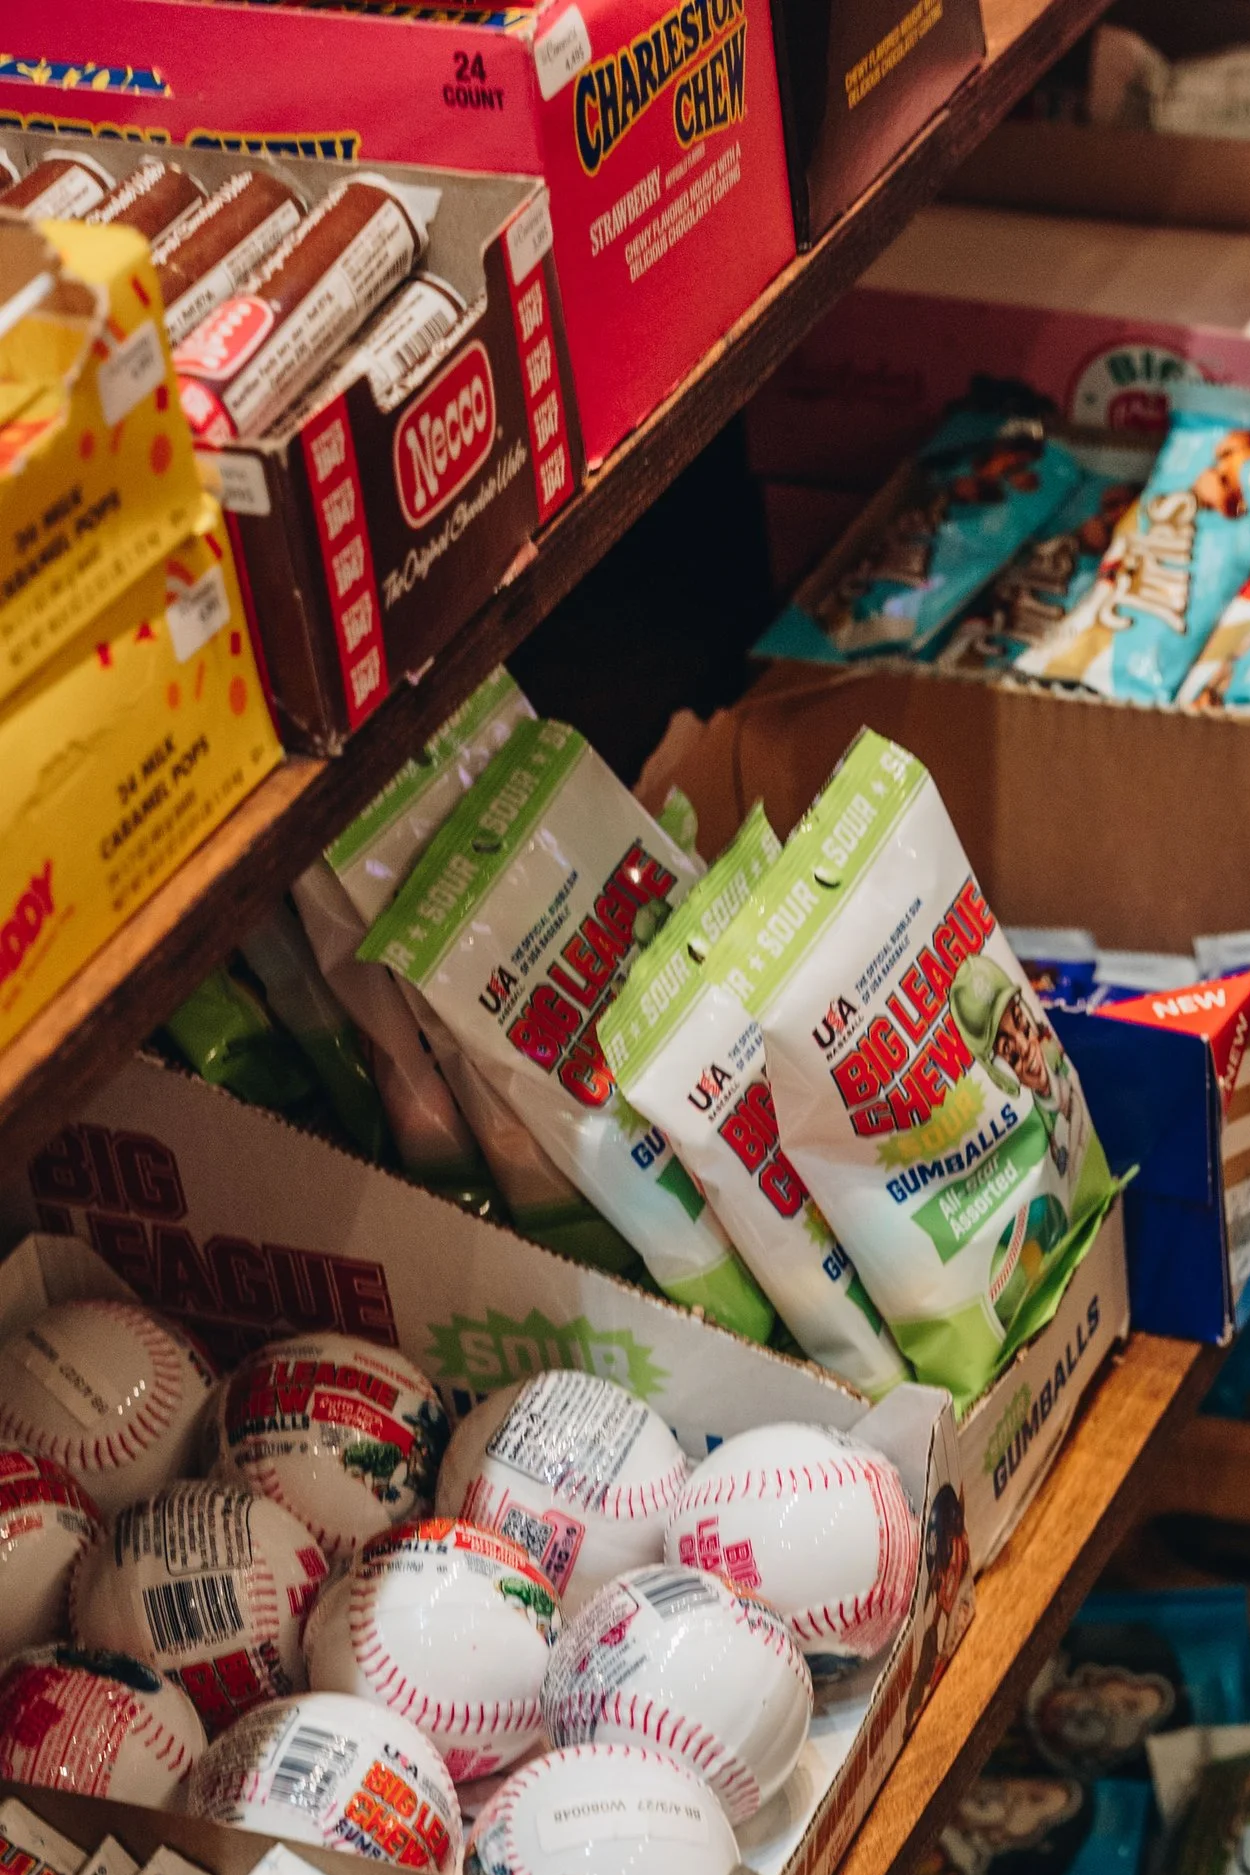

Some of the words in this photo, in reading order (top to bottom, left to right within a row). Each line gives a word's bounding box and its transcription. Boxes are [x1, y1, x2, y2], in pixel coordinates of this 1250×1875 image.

[442, 85, 504, 111] COUNT
[453, 51, 486, 84] 24
[673, 17, 747, 149] CHEW
[589, 164, 661, 258] STRAWBERRY
[625, 225, 651, 266] CHEWY
[652, 189, 690, 237] FLAVORED
[629, 234, 669, 284] DELICIOUS
[712, 161, 742, 205] COATING
[405, 373, 488, 513] Necco
[477, 766, 540, 836] SOUR
[822, 793, 878, 869] SOUR
[420, 853, 481, 925] SOUR
[701, 871, 751, 942] SOUR
[757, 880, 821, 958] SOUR
[641, 951, 692, 1026] SOUR
[886, 873, 997, 1047] LEAGUE
[505, 980, 586, 1077] BIG
[1150, 988, 1228, 1020] NEW
[829, 1012, 911, 1112] BIG
[845, 1007, 976, 1139] CHEW
[1224, 1012, 1250, 1092] NEW
[28, 1121, 189, 1224] BIG
[885, 1102, 1019, 1207] GUMBALLS
[947, 1164, 1019, 1242] Assorted
[276, 1360, 400, 1414] LEAGUE
[457, 1327, 633, 1386] SOUR
[992, 1296, 1102, 1501] GUMBALLS
[362, 1759, 419, 1820] BIG
[344, 1791, 430, 1869] CHEW
